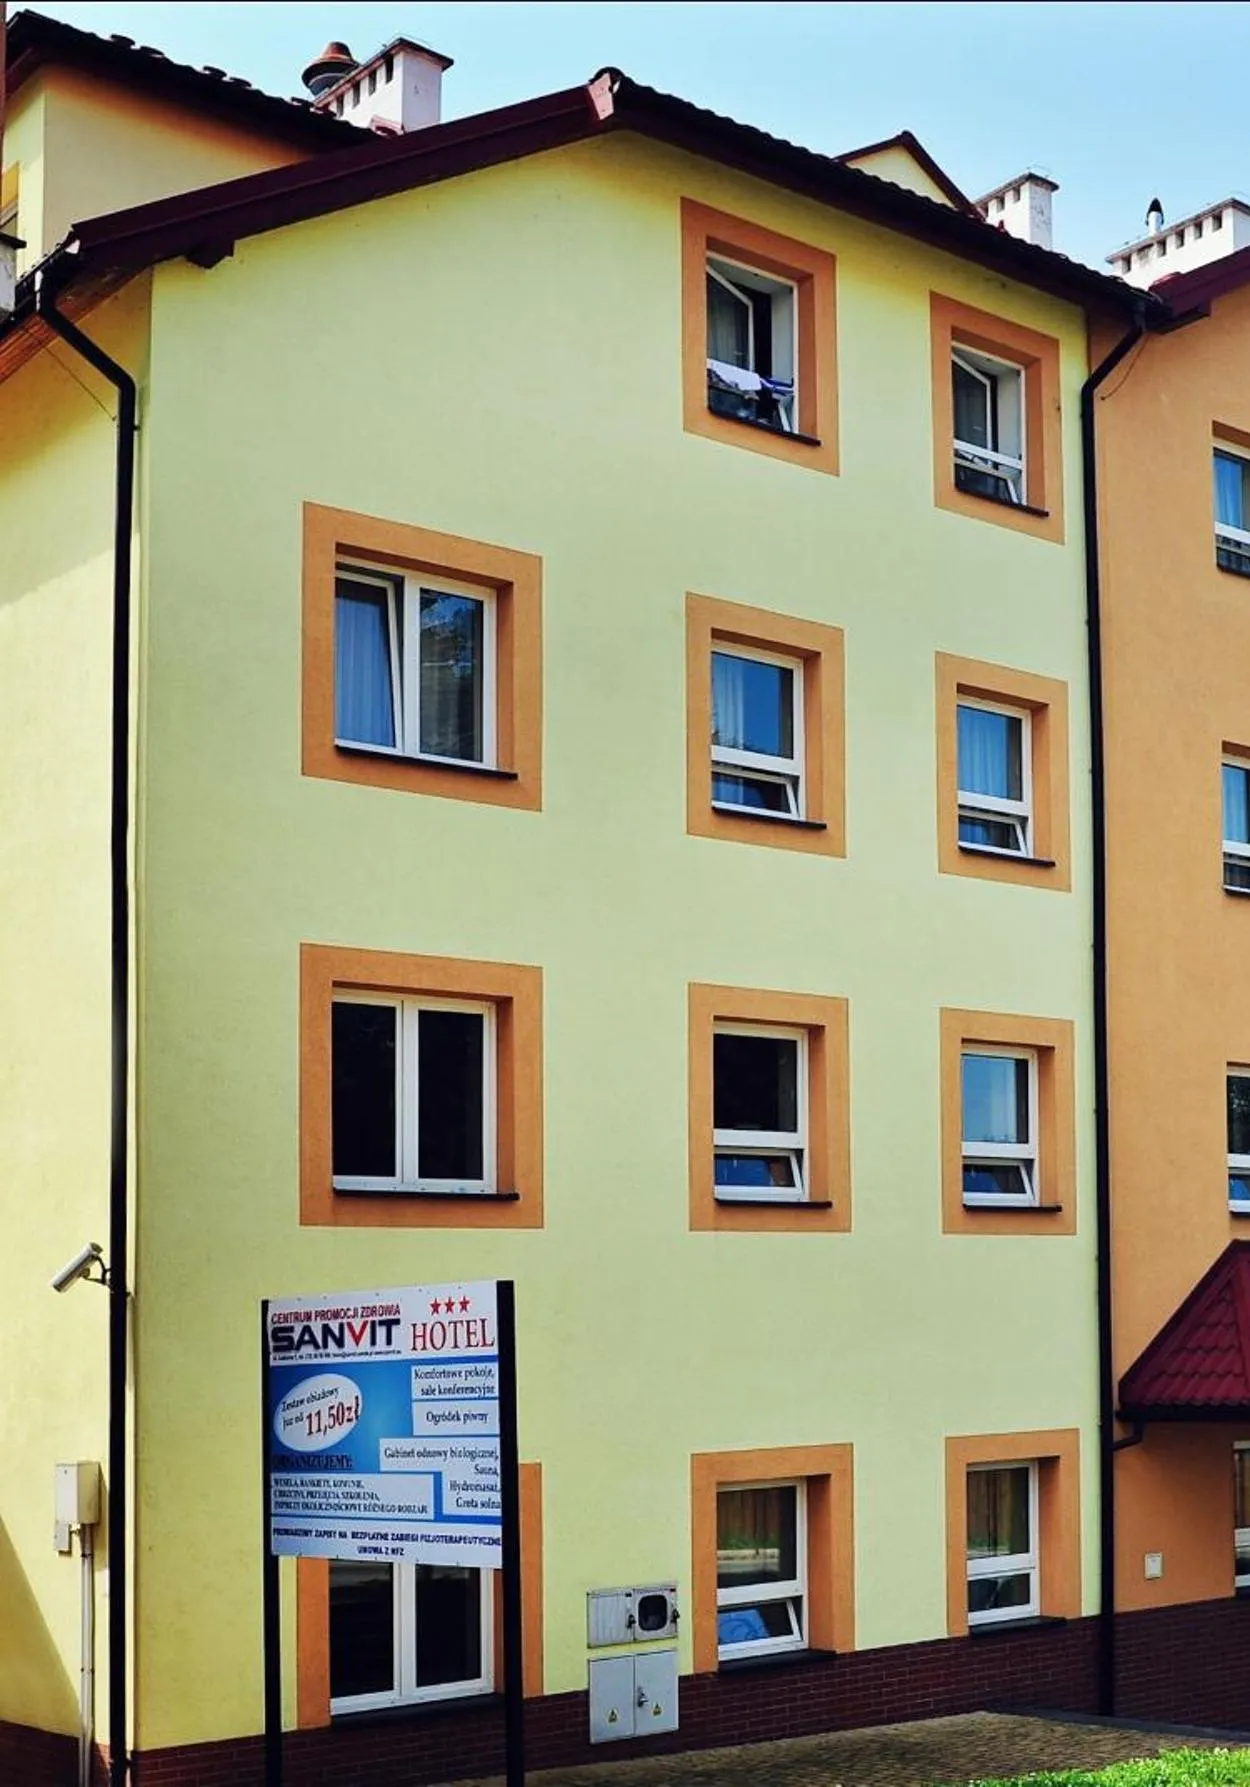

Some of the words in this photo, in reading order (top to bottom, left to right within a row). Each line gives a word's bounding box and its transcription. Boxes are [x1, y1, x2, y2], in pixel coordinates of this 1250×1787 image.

[271, 1310, 312, 1325] CENTRUM
[314, 1306, 358, 1322] PROMOCJI
[361, 1303, 401, 1318] ZDROWIA
[271, 1318, 401, 1353] SANVIT
[410, 1318, 495, 1351] HOTEL
[306, 1395, 360, 1436] 11,50zł
[426, 1410, 461, 1425] Ogródek
